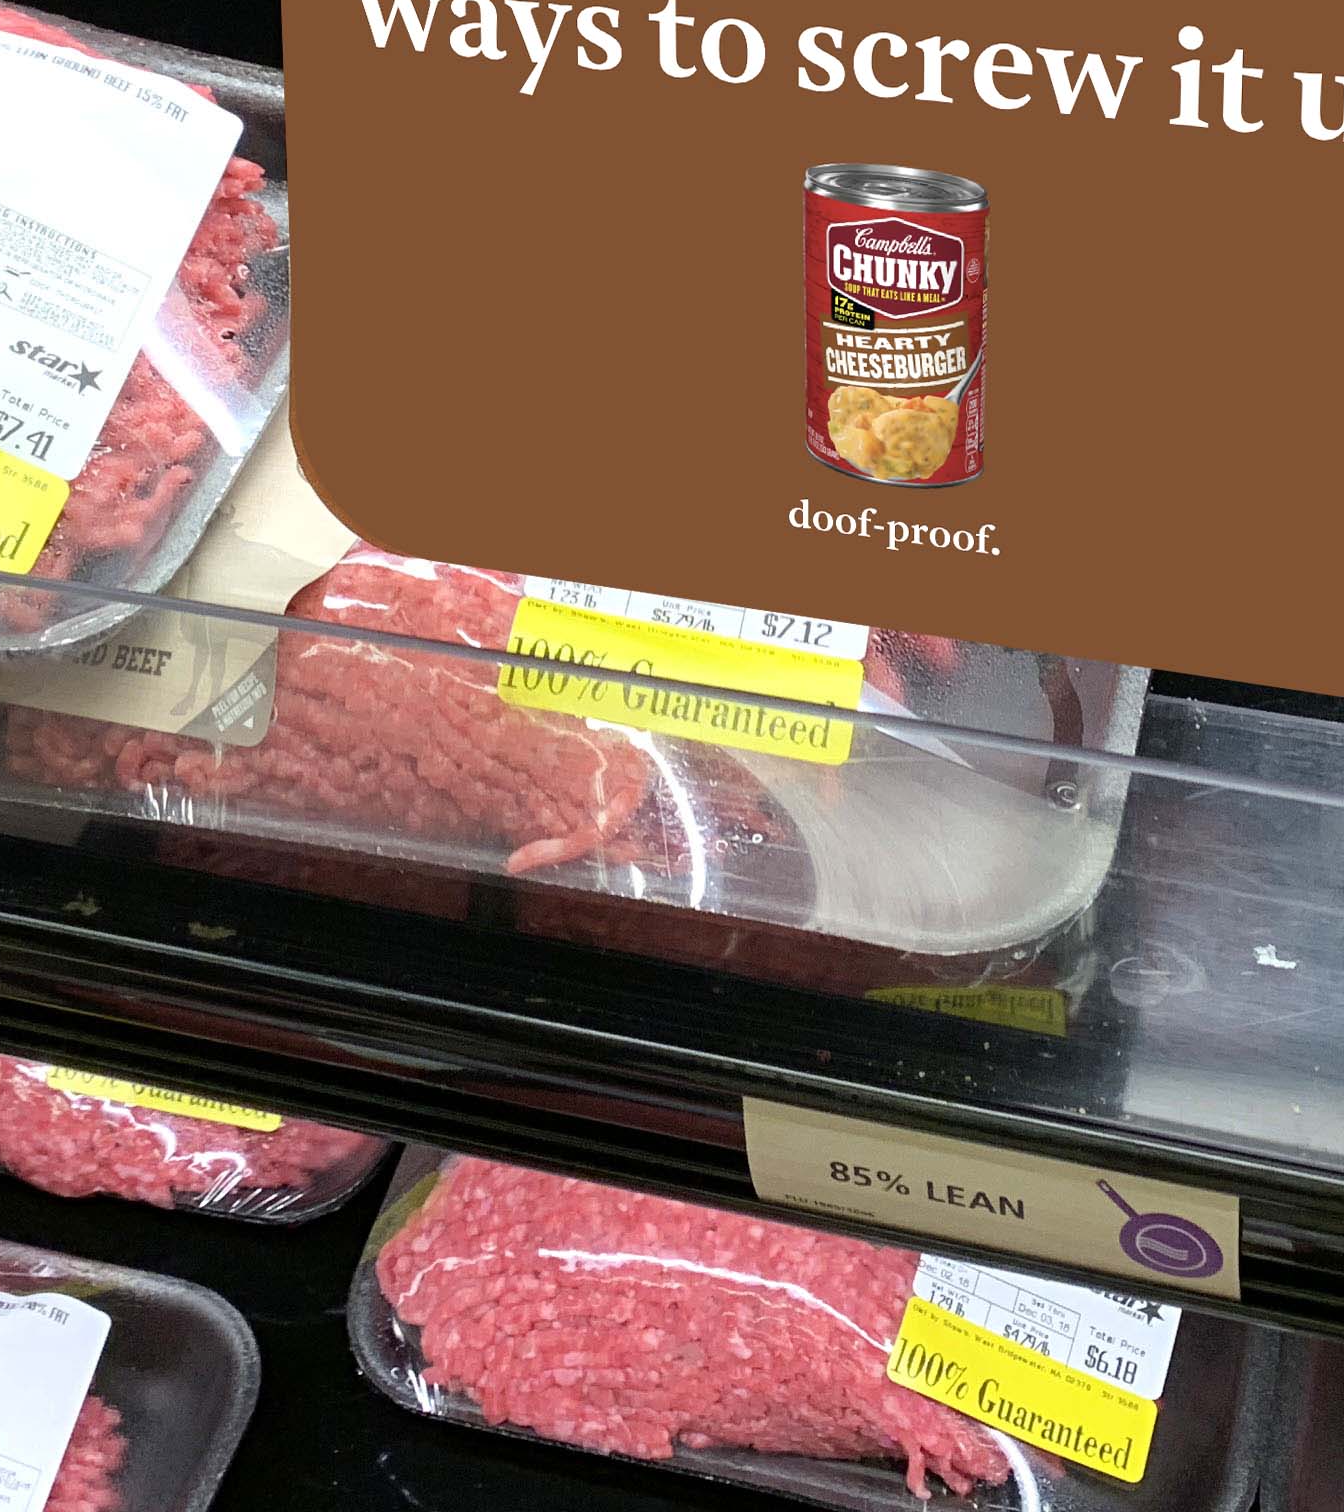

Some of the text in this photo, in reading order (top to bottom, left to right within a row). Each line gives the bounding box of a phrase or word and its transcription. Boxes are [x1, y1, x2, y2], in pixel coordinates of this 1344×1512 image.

[798, 26, 1144, 119] screw
[1170, 25, 1264, 133] it
[854, 226, 936, 256] Campbell's
[832, 243, 958, 295] CHUNKY
[844, 282, 861, 295] SOUP
[863, 286, 880, 298] THAT
[881, 288, 898, 301] EATS
[900, 291, 915, 302] LIKE
[834, 306, 871, 321] PROTEIN
[9, 339, 79, 374] star
[836, 331, 952, 351] HEARTY
[825, 345, 967, 380] CHEESEBURGER
[0, 388, 70, 431] Total Price
[788, 498, 1001, 556] doof-proof.
[761, 613, 833, 648] $7.12
[112, 645, 173, 677] BEEF
[829, 1160, 1025, 1220] 85% LEAN
[1084, 1344, 1138, 1386] $6.18
[1120, 1338, 1146, 1358] Price
[892, 1336, 1135, 1474] 100% Guaranteed
